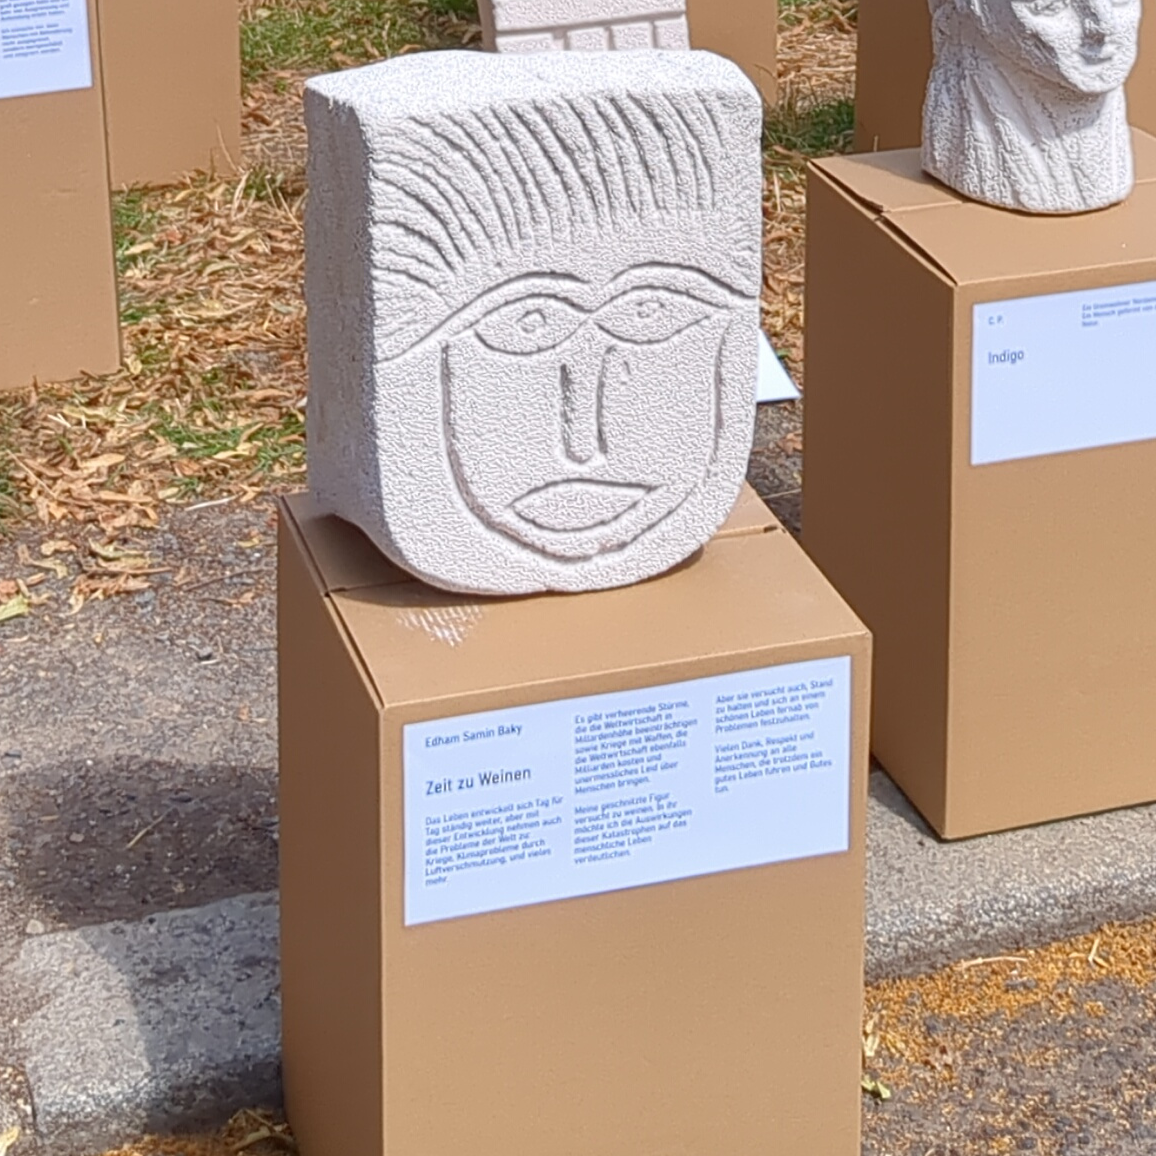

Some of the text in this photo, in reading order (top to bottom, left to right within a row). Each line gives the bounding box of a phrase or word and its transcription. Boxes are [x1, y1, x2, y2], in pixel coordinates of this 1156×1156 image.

[988, 349, 1024, 364] Indigo
[425, 724, 523, 747] Edham Samin Baky
[426, 769, 531, 795] Zeit zu Weinen
